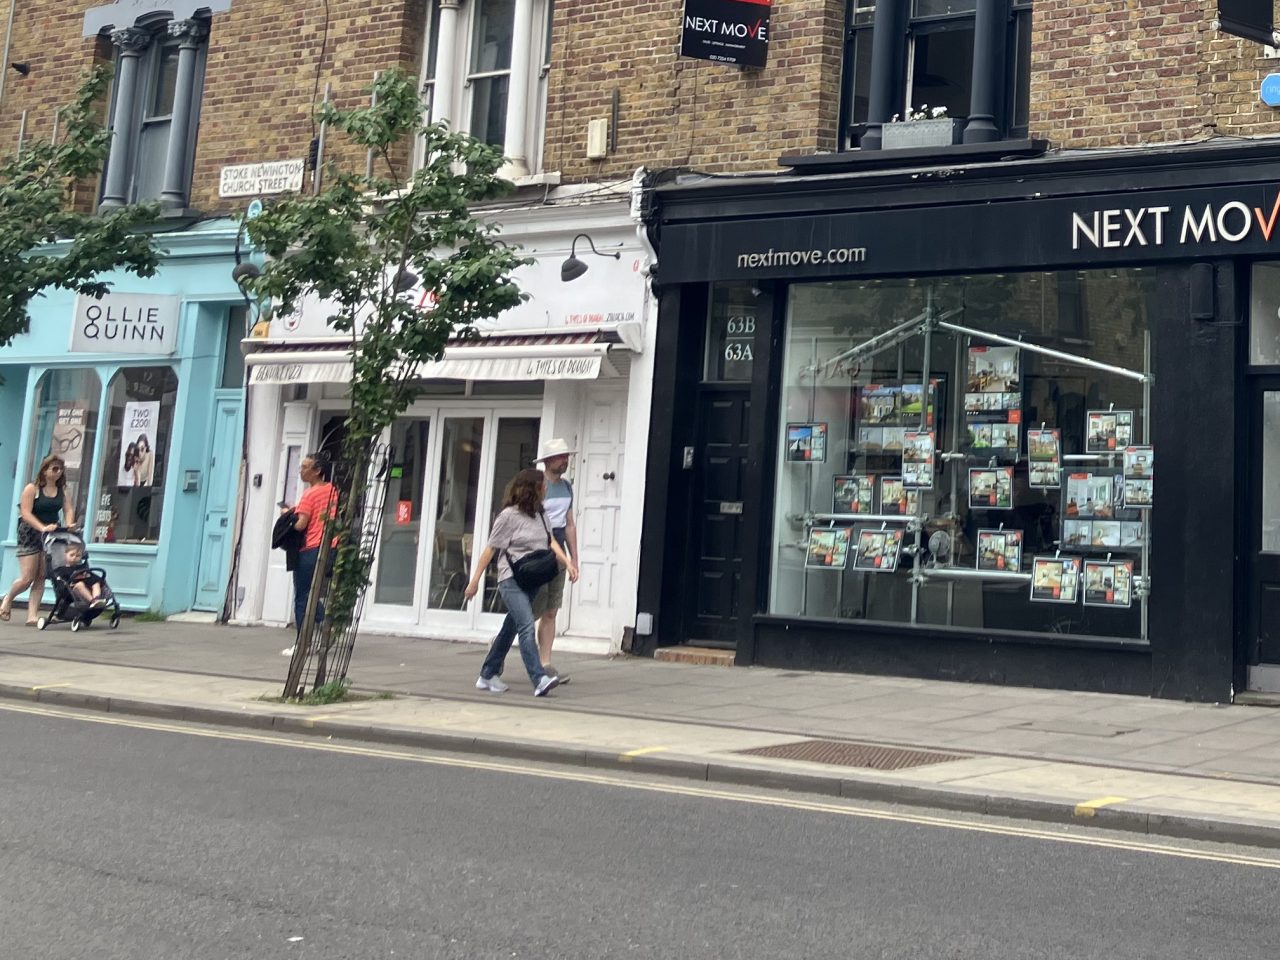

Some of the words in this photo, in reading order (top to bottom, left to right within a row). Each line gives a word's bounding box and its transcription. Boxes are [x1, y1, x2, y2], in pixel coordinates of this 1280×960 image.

[685, 16, 719, 33] NEXT
[721, 19, 766, 40] MOVE
[223, 167, 249, 181] STOKE
[250, 162, 303, 179] NEWINGTON
[222, 179, 256, 194] CHURCH
[258, 177, 289, 191] STREET
[1072, 206, 1172, 250] NEXT
[737, 247, 867, 268] nextmove.com
[86, 305, 159, 324] OLLIE
[83, 323, 164, 341] QUINN
[727, 316, 756, 334] 63B
[724, 343, 754, 361] 63A
[71, 408, 84, 416] ONE
[132, 409, 149, 418] TWO
